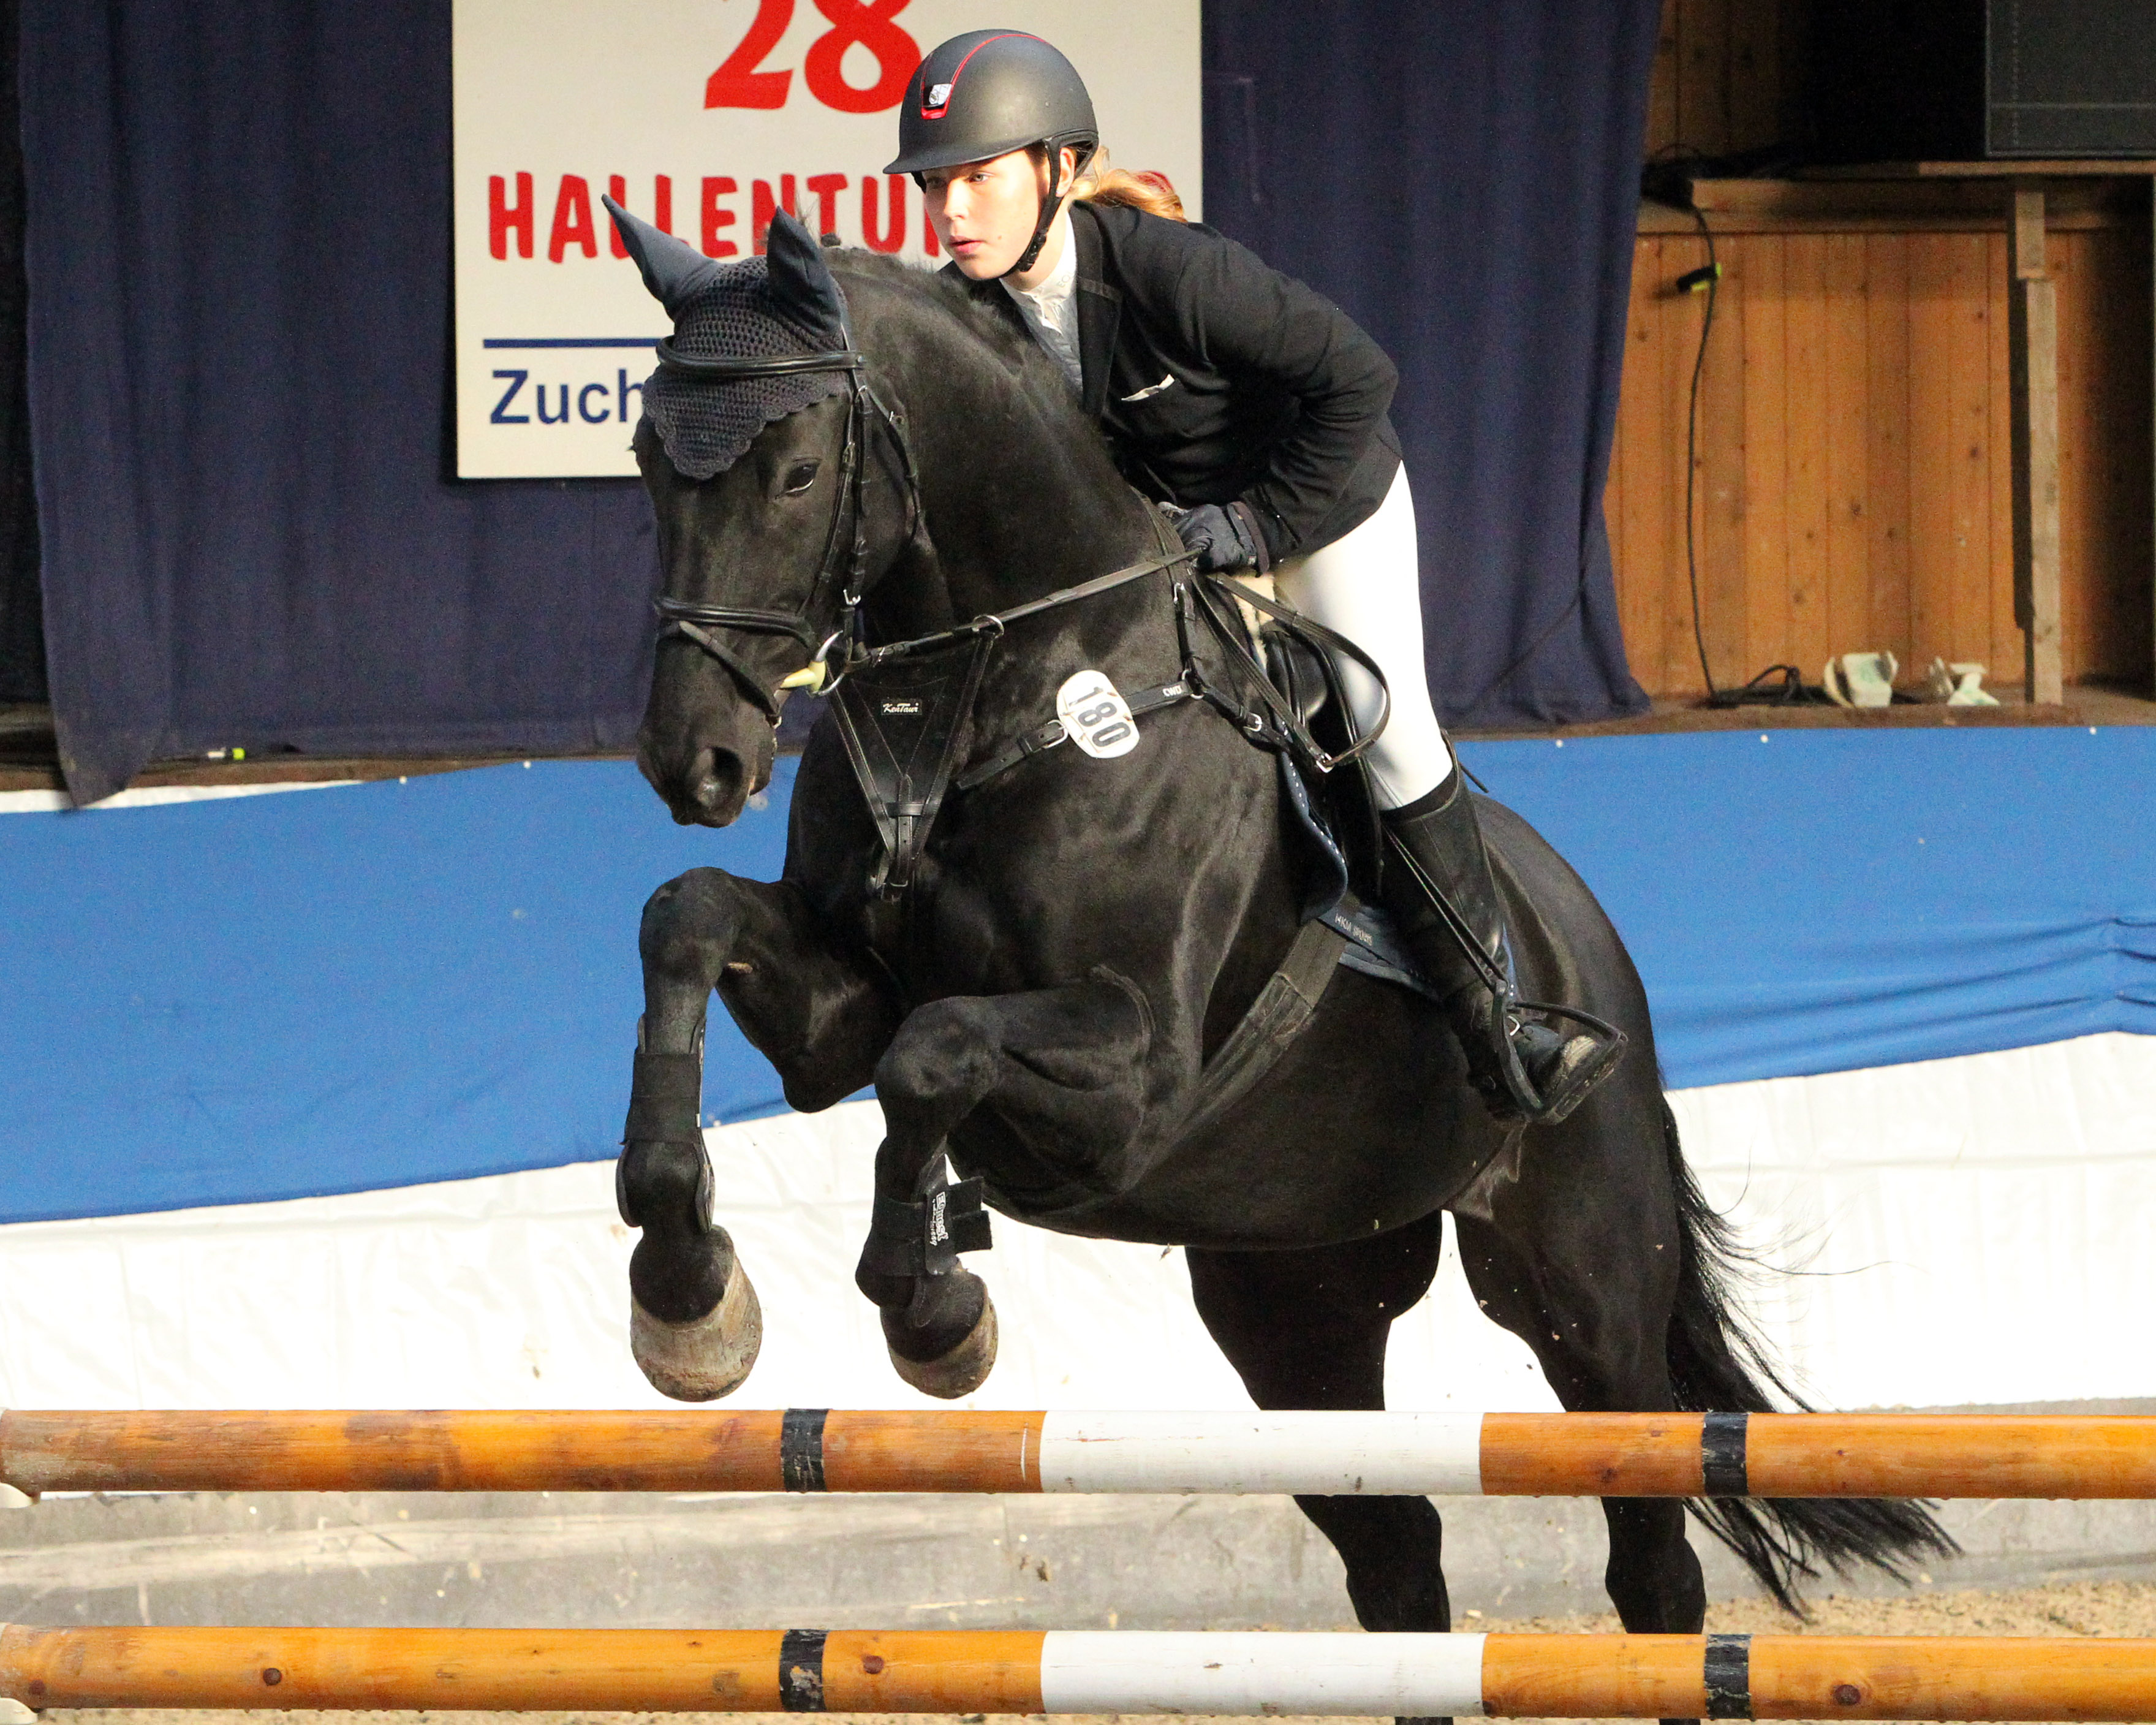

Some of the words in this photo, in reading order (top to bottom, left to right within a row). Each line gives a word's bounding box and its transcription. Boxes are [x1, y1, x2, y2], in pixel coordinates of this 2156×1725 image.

[704, 0, 922, 114] 28
[489, 170, 939, 263] HALLENTU
[1069, 686, 1131, 747] 180
[1162, 685, 1182, 697] CWD
